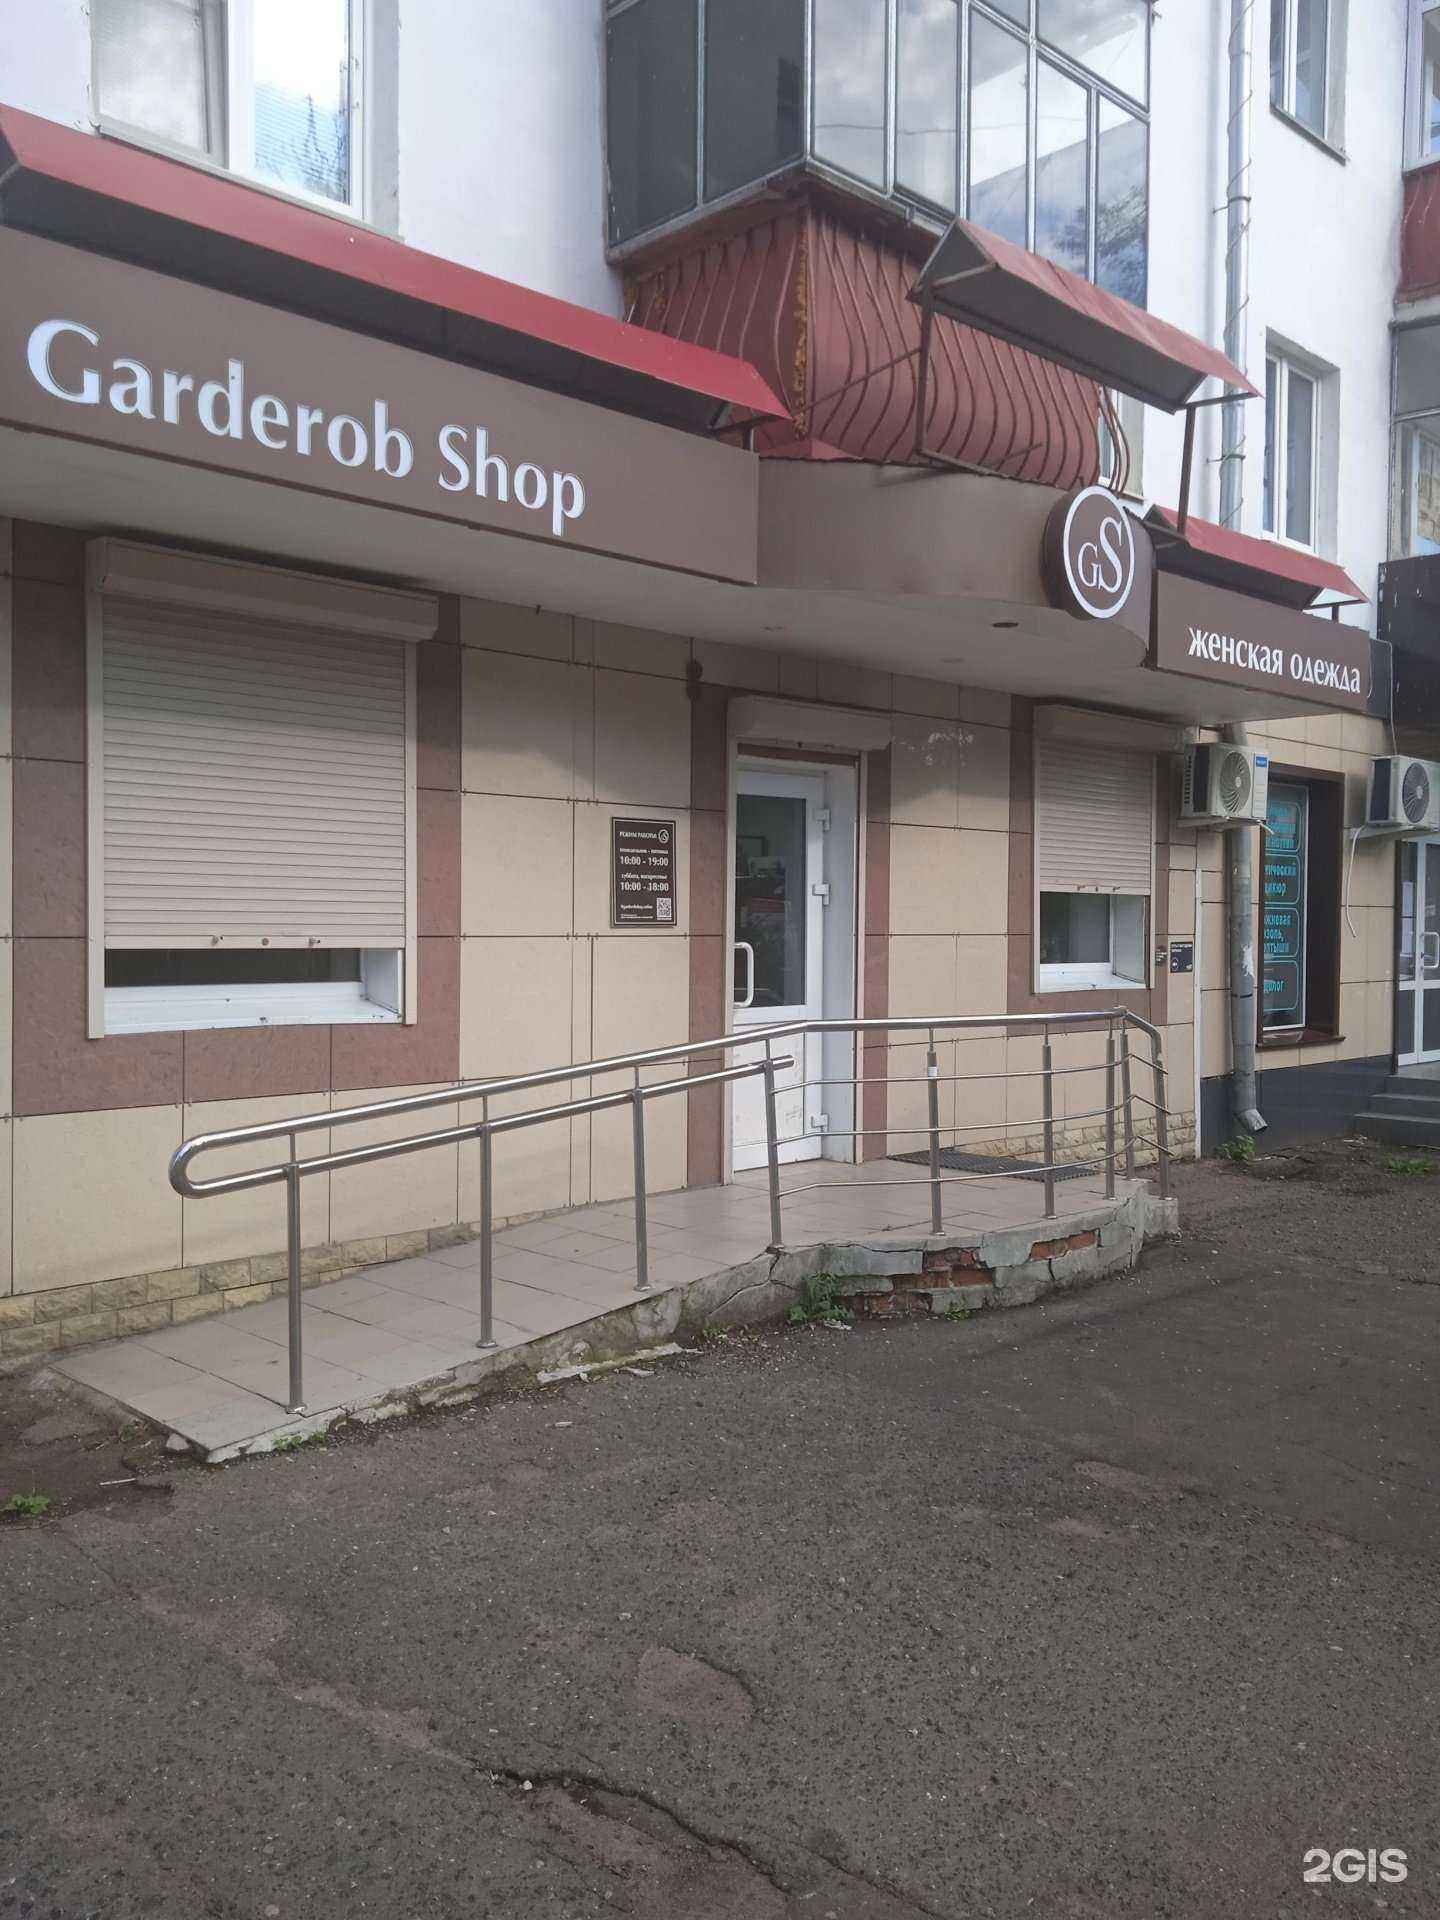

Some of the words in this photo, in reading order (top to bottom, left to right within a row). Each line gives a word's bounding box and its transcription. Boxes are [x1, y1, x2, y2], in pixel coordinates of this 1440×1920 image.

[26, 318, 414, 479] Garderob
[437, 423, 586, 536] Shop
[1188, 627, 1283, 675] женская
[1290, 653, 1361, 693] одежда
[620, 856, 641, 865] 10:00
[648, 857, 669, 866] 19:00
[620, 881, 641, 891] 10:00
[648, 882, 669, 891] 18:00
